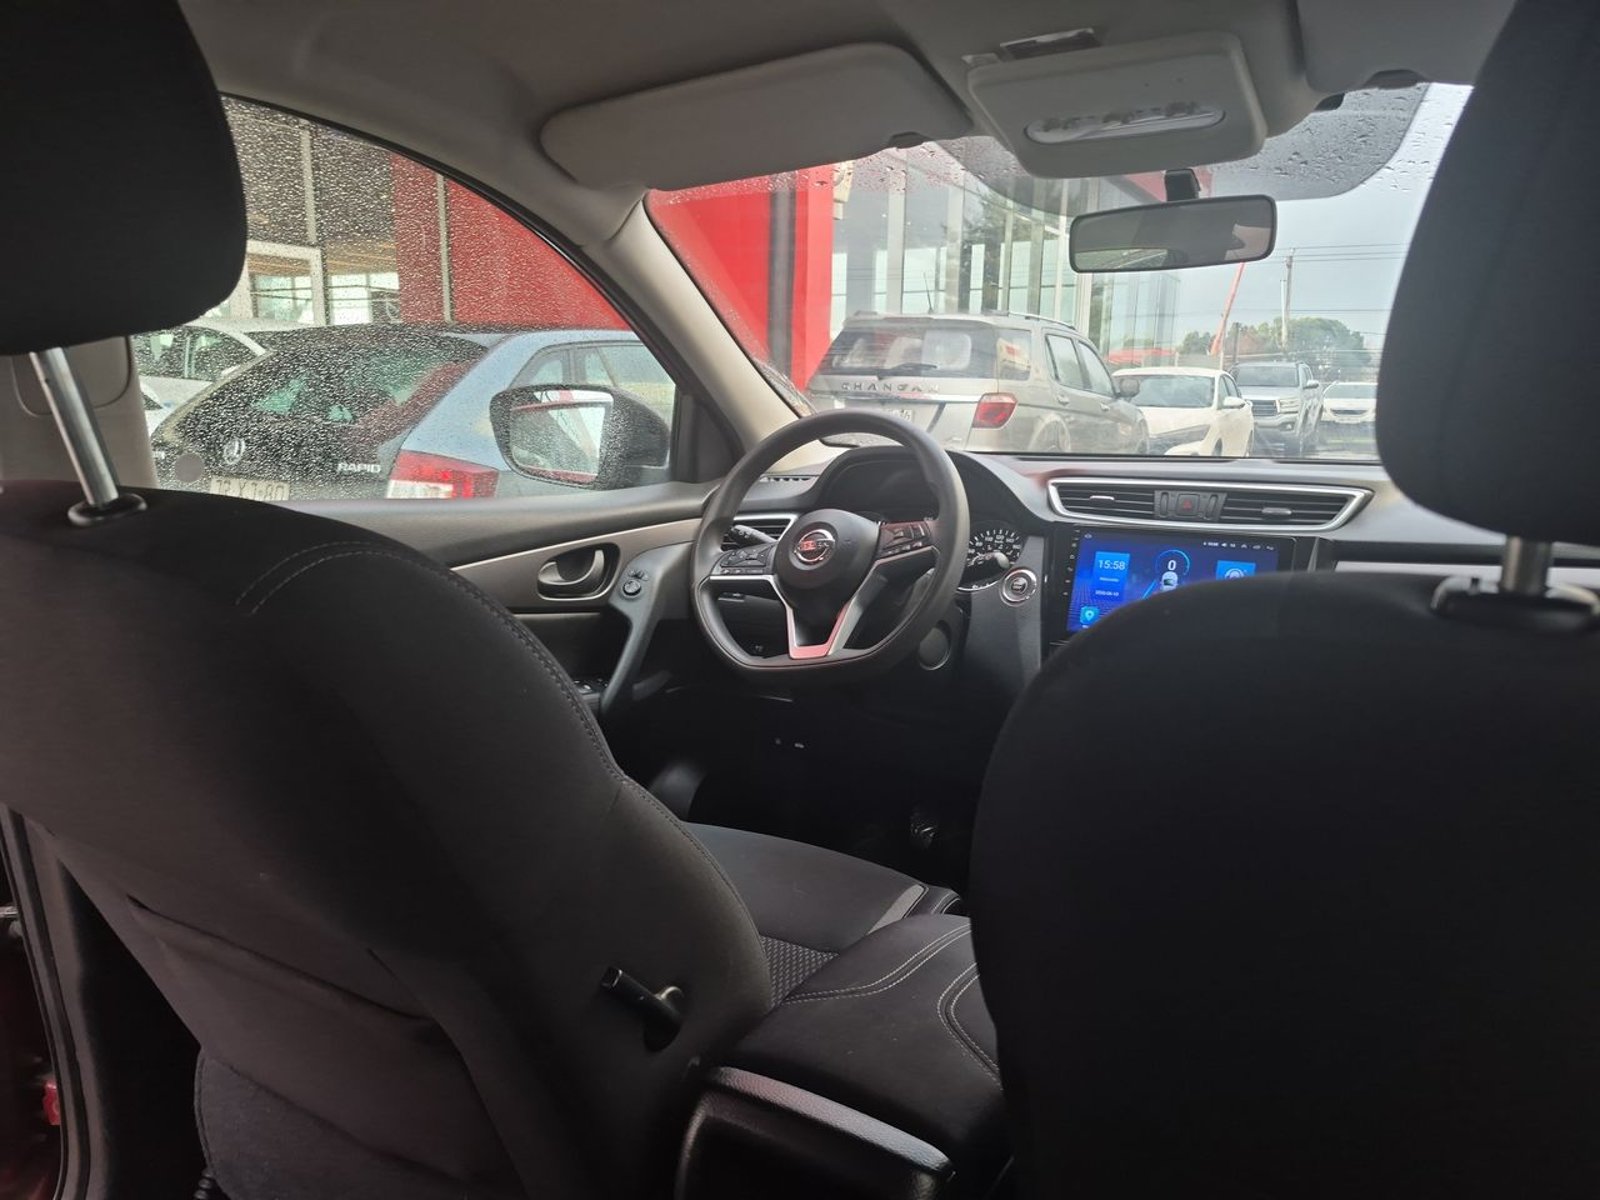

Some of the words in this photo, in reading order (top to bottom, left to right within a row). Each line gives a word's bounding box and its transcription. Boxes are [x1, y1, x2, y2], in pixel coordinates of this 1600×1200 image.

[841, 382, 938, 393] CHANGAN
[338, 462, 381, 473] RAPID
[1098, 559, 1126, 571] 15:58
[1167, 559, 1177, 571] 0
